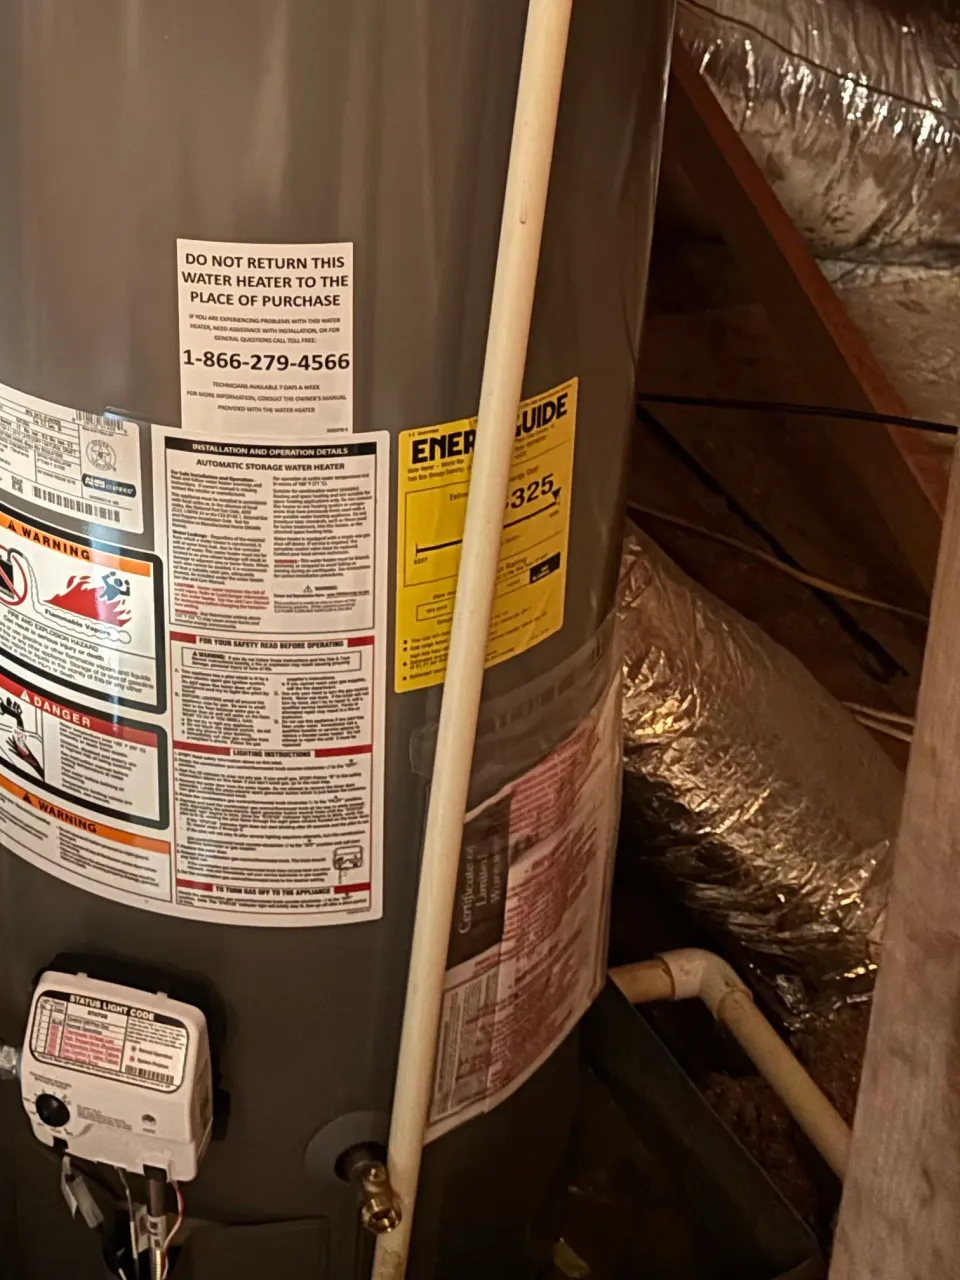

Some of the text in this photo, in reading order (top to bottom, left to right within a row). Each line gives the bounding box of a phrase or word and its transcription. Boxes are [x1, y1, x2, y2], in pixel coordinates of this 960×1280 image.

[185, 253, 345, 269] DO NOT RETURN THIS
[182, 272, 349, 288] WATER HEATER TO THE
[190, 292, 340, 308] PLACE OF PURCHASE
[183, 349, 350, 371] 1-866-279-4566
[192, 443, 248, 455] INSTALLATION
[269, 448, 315, 456] OPERATION
[316, 447, 348, 455] DETAILS
[196, 459, 345, 471] AUTOMATIC STORAGE WATER HEATER
[506, 473, 554, 509] 325
[21, 526, 90, 561] WARNING
[7, 609, 99, 652] FIRE AND EXPLOSION HAZARD
[44, 608, 111, 636] Flammable Vapors
[34, 696, 90, 728] DANGER
[37, 800, 97, 834] WARNING
[69, 995, 155, 1021] STATUS LIGHT CODE
